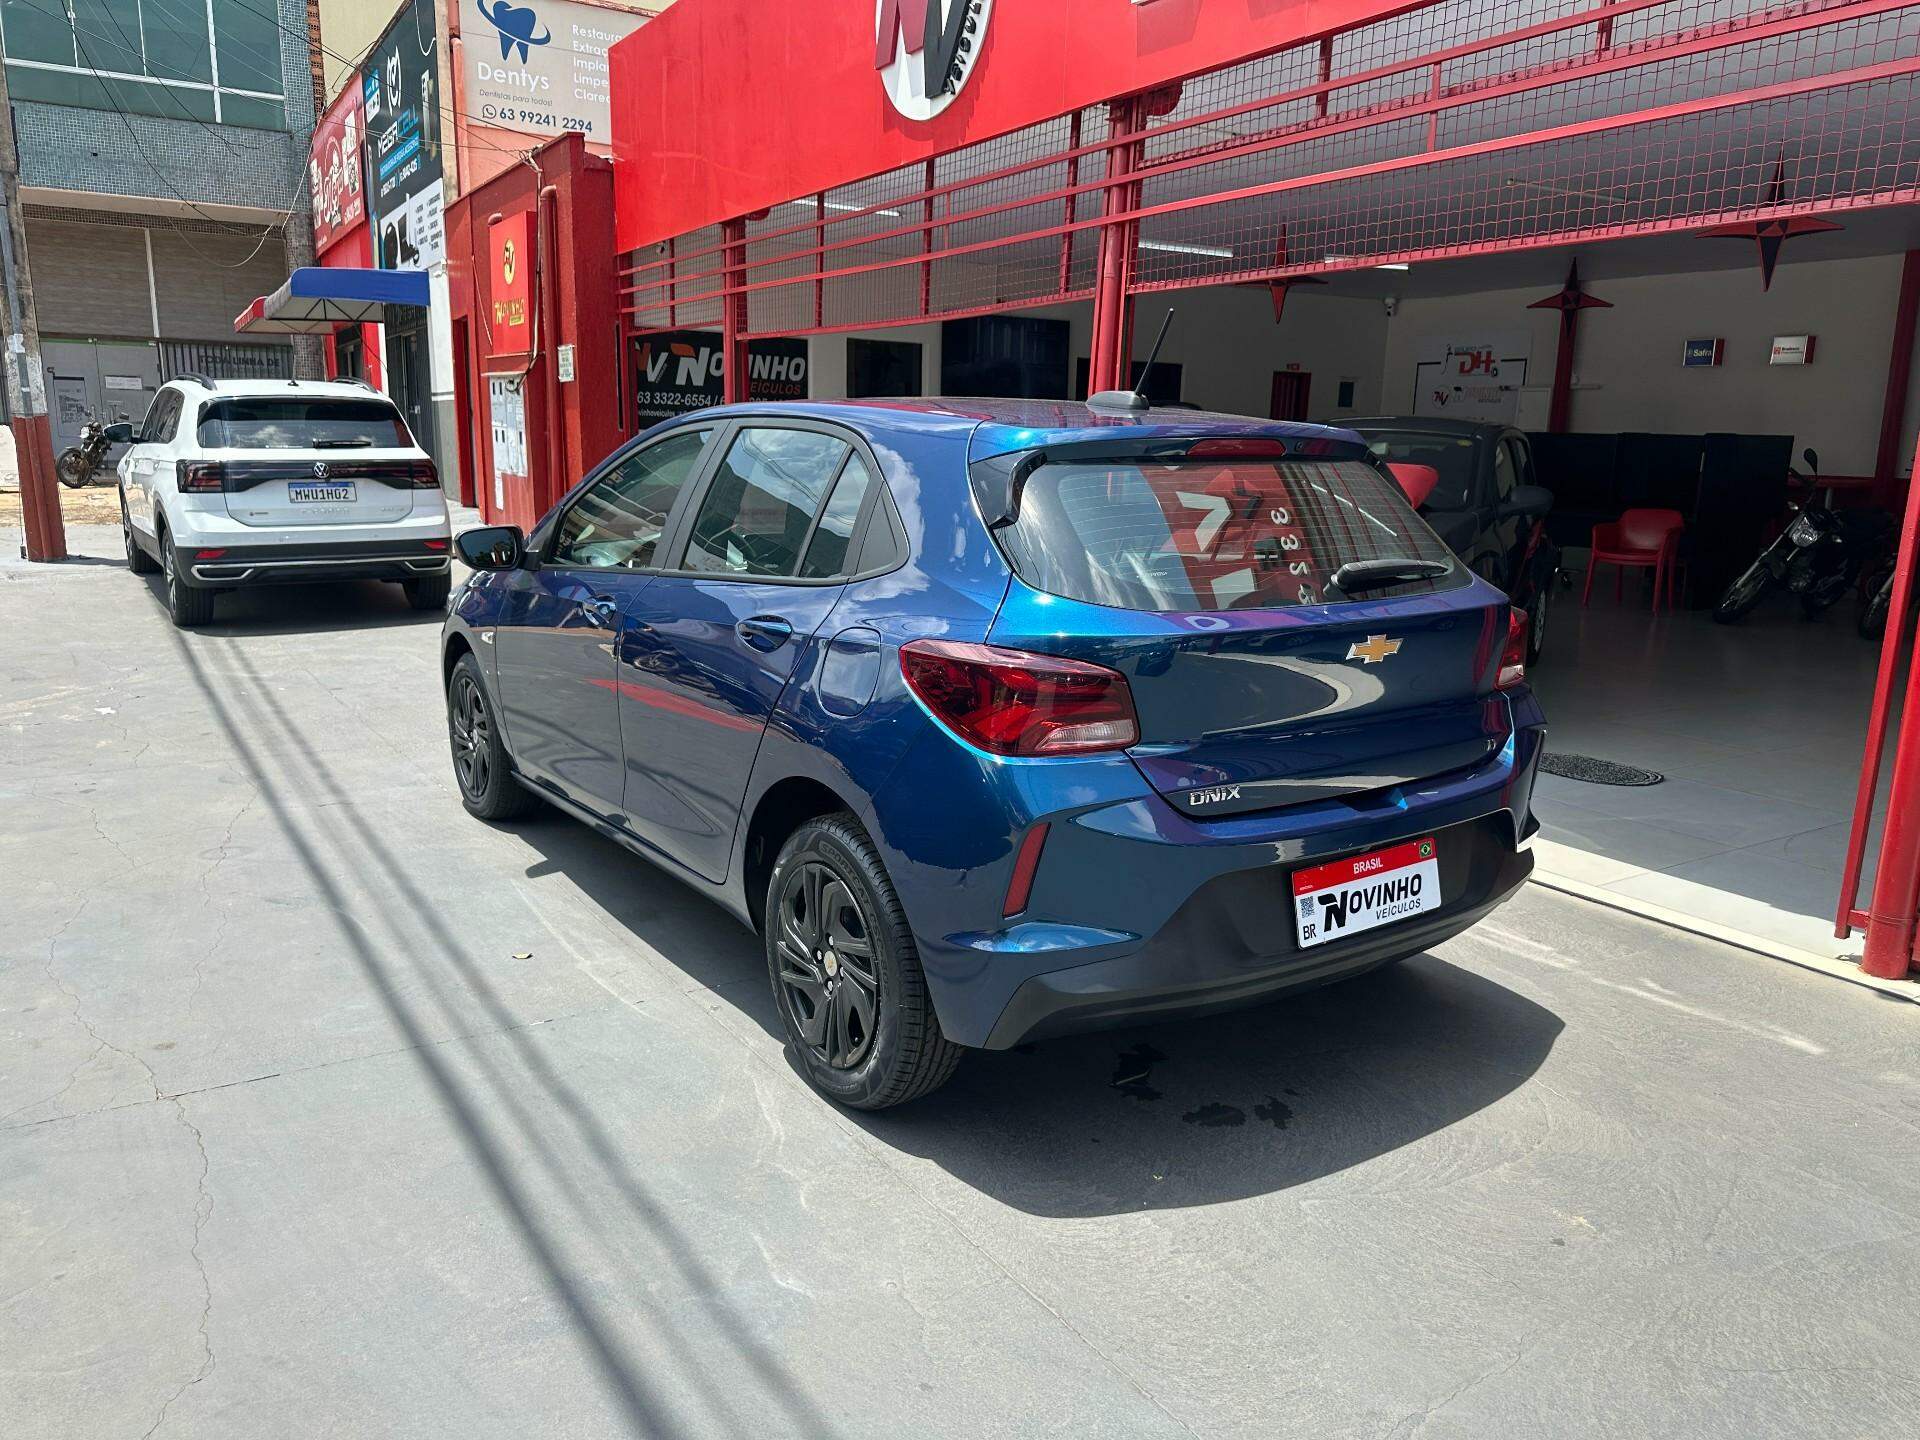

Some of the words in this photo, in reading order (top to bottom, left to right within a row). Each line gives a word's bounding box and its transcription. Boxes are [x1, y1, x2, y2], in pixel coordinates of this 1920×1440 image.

[573, 56, 609, 72] Impla
[477, 61, 550, 92] Dentys
[479, 88, 511, 101] Dentistas
[512, 95, 530, 106] para
[500, 108, 515, 120] 63
[519, 110, 558, 127] 99241
[562, 117, 593, 133] 2294
[200, 355, 231, 364] TODA
[233, 356, 264, 367] LINHA
[267, 358, 280, 367] DE
[637, 391, 651, 404] 63
[653, 391, 711, 407] 3322-6554
[1353, 857, 1384, 875] BRASIL
[1317, 872, 1421, 932] NOVINHO
[1375, 898, 1421, 920] VEÍCULOS
[1302, 923, 1317, 941] BR
